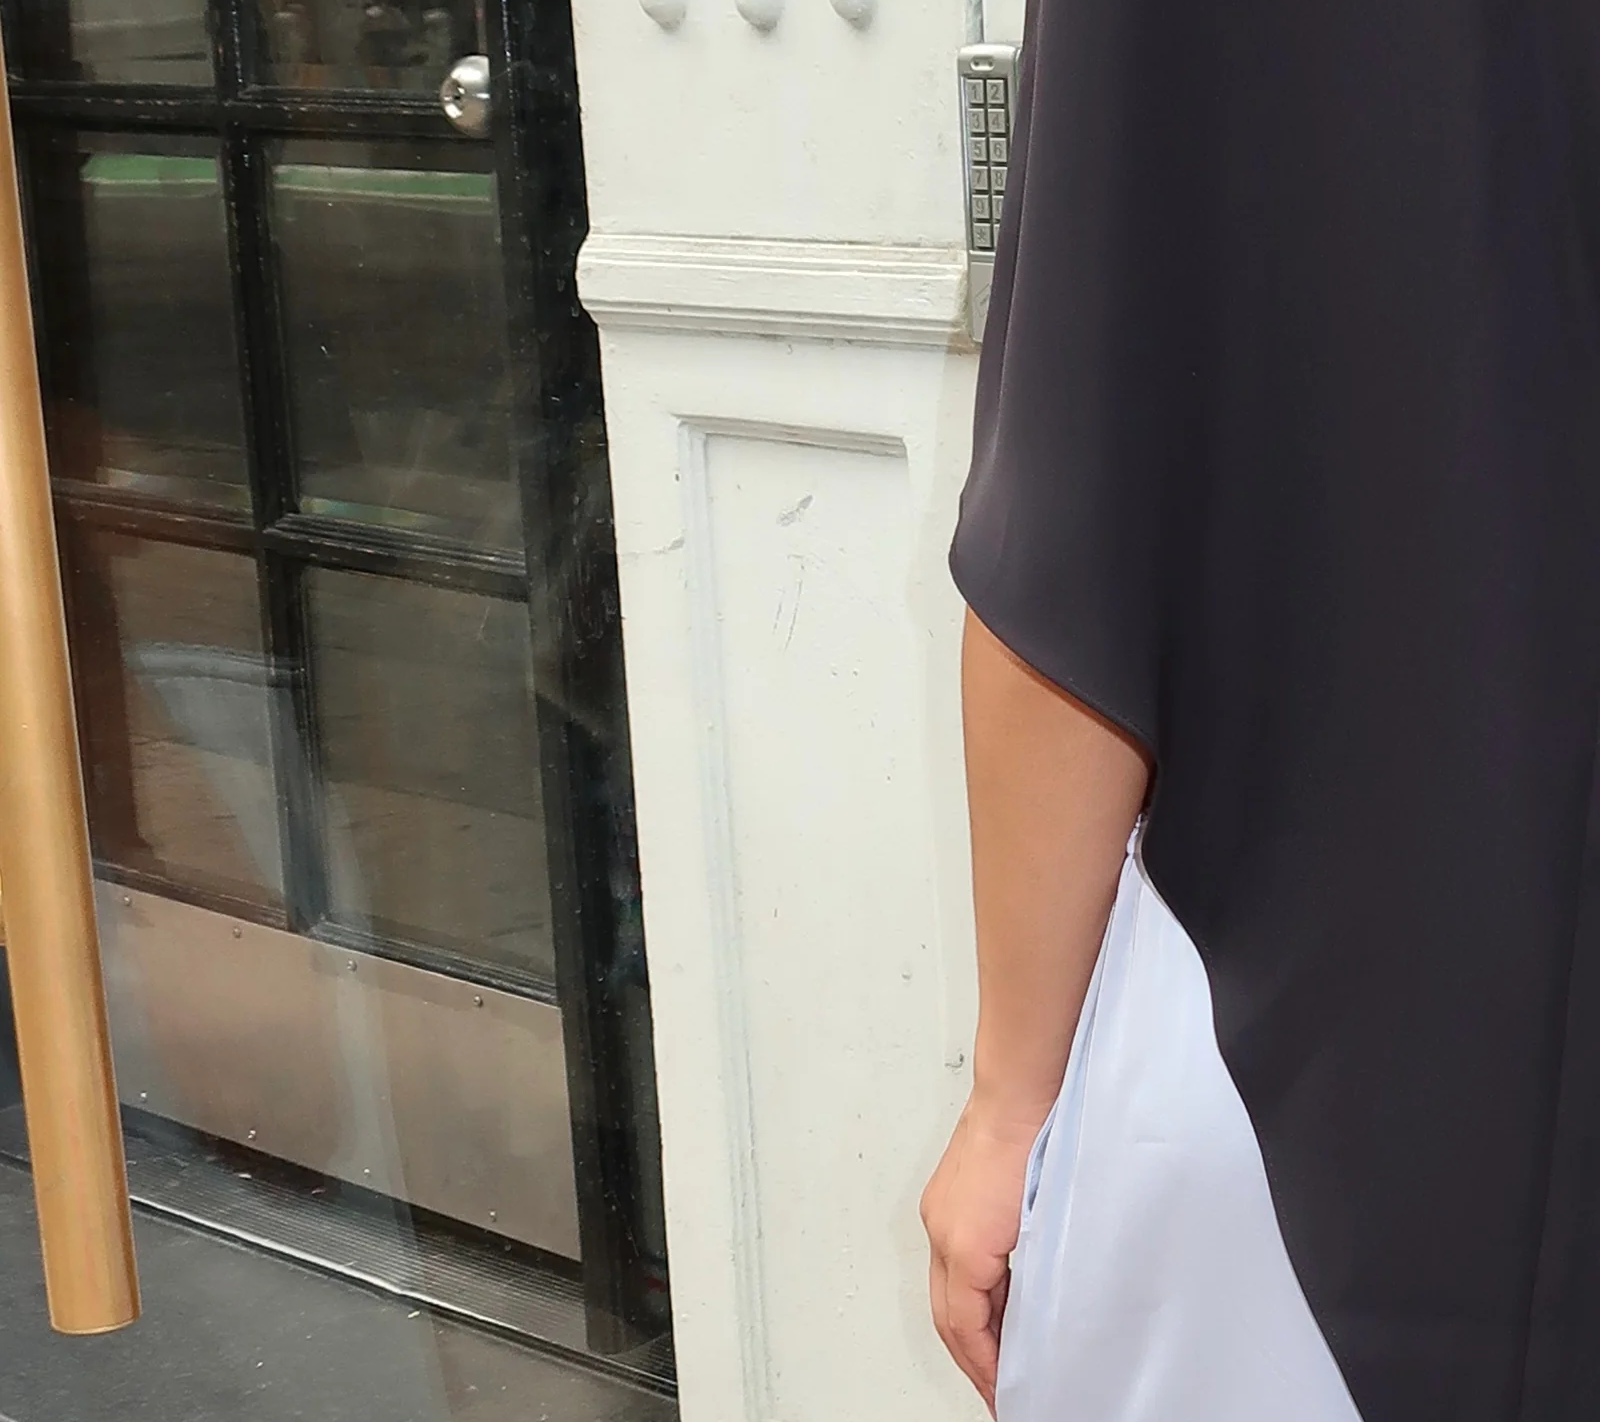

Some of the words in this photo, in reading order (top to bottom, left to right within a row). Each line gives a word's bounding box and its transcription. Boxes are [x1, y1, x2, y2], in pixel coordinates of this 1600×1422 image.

[971, 84, 978, 100] 1
[990, 84, 1000, 100] 2
[972, 113, 981, 129] 3
[991, 113, 1000, 130] 4
[974, 143, 982, 158] 5
[994, 142, 1003, 158] 6
[974, 169, 982, 185] 7
[995, 170, 1004, 188] 8
[975, 199, 985, 216] 9
